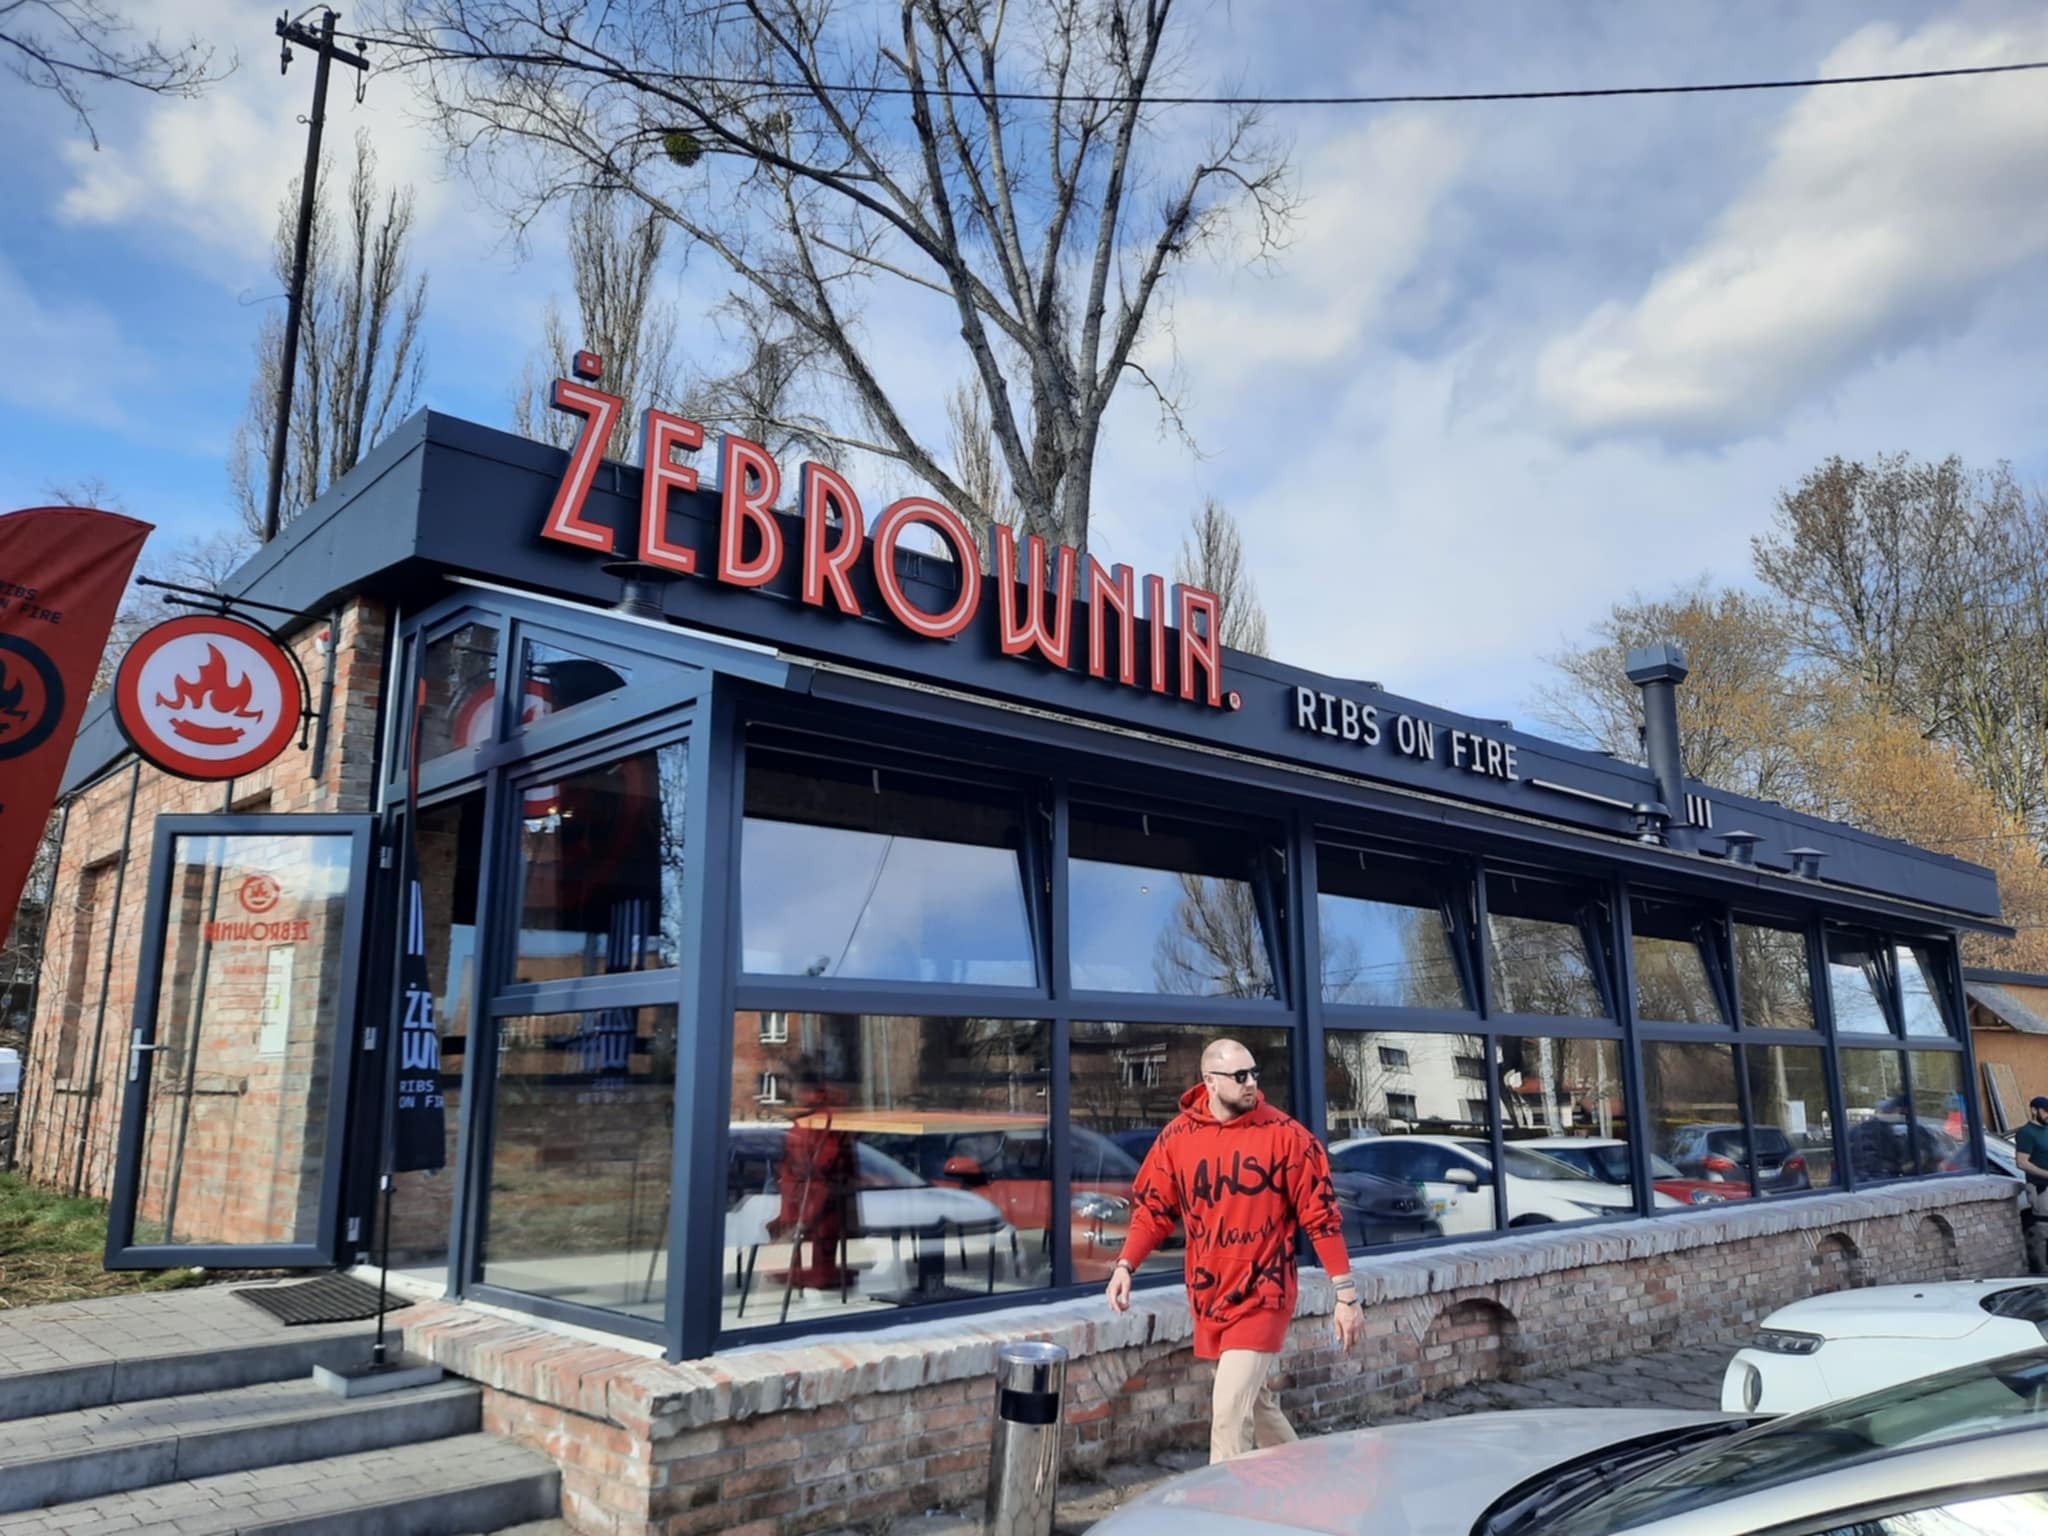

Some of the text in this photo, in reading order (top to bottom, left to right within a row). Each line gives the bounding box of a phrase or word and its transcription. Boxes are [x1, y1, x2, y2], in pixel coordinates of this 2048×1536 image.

[19, 602, 64, 625] FIRE
[1296, 685, 1520, 781] RIBS ON FIRE
[400, 1080, 435, 1093] RIBS
